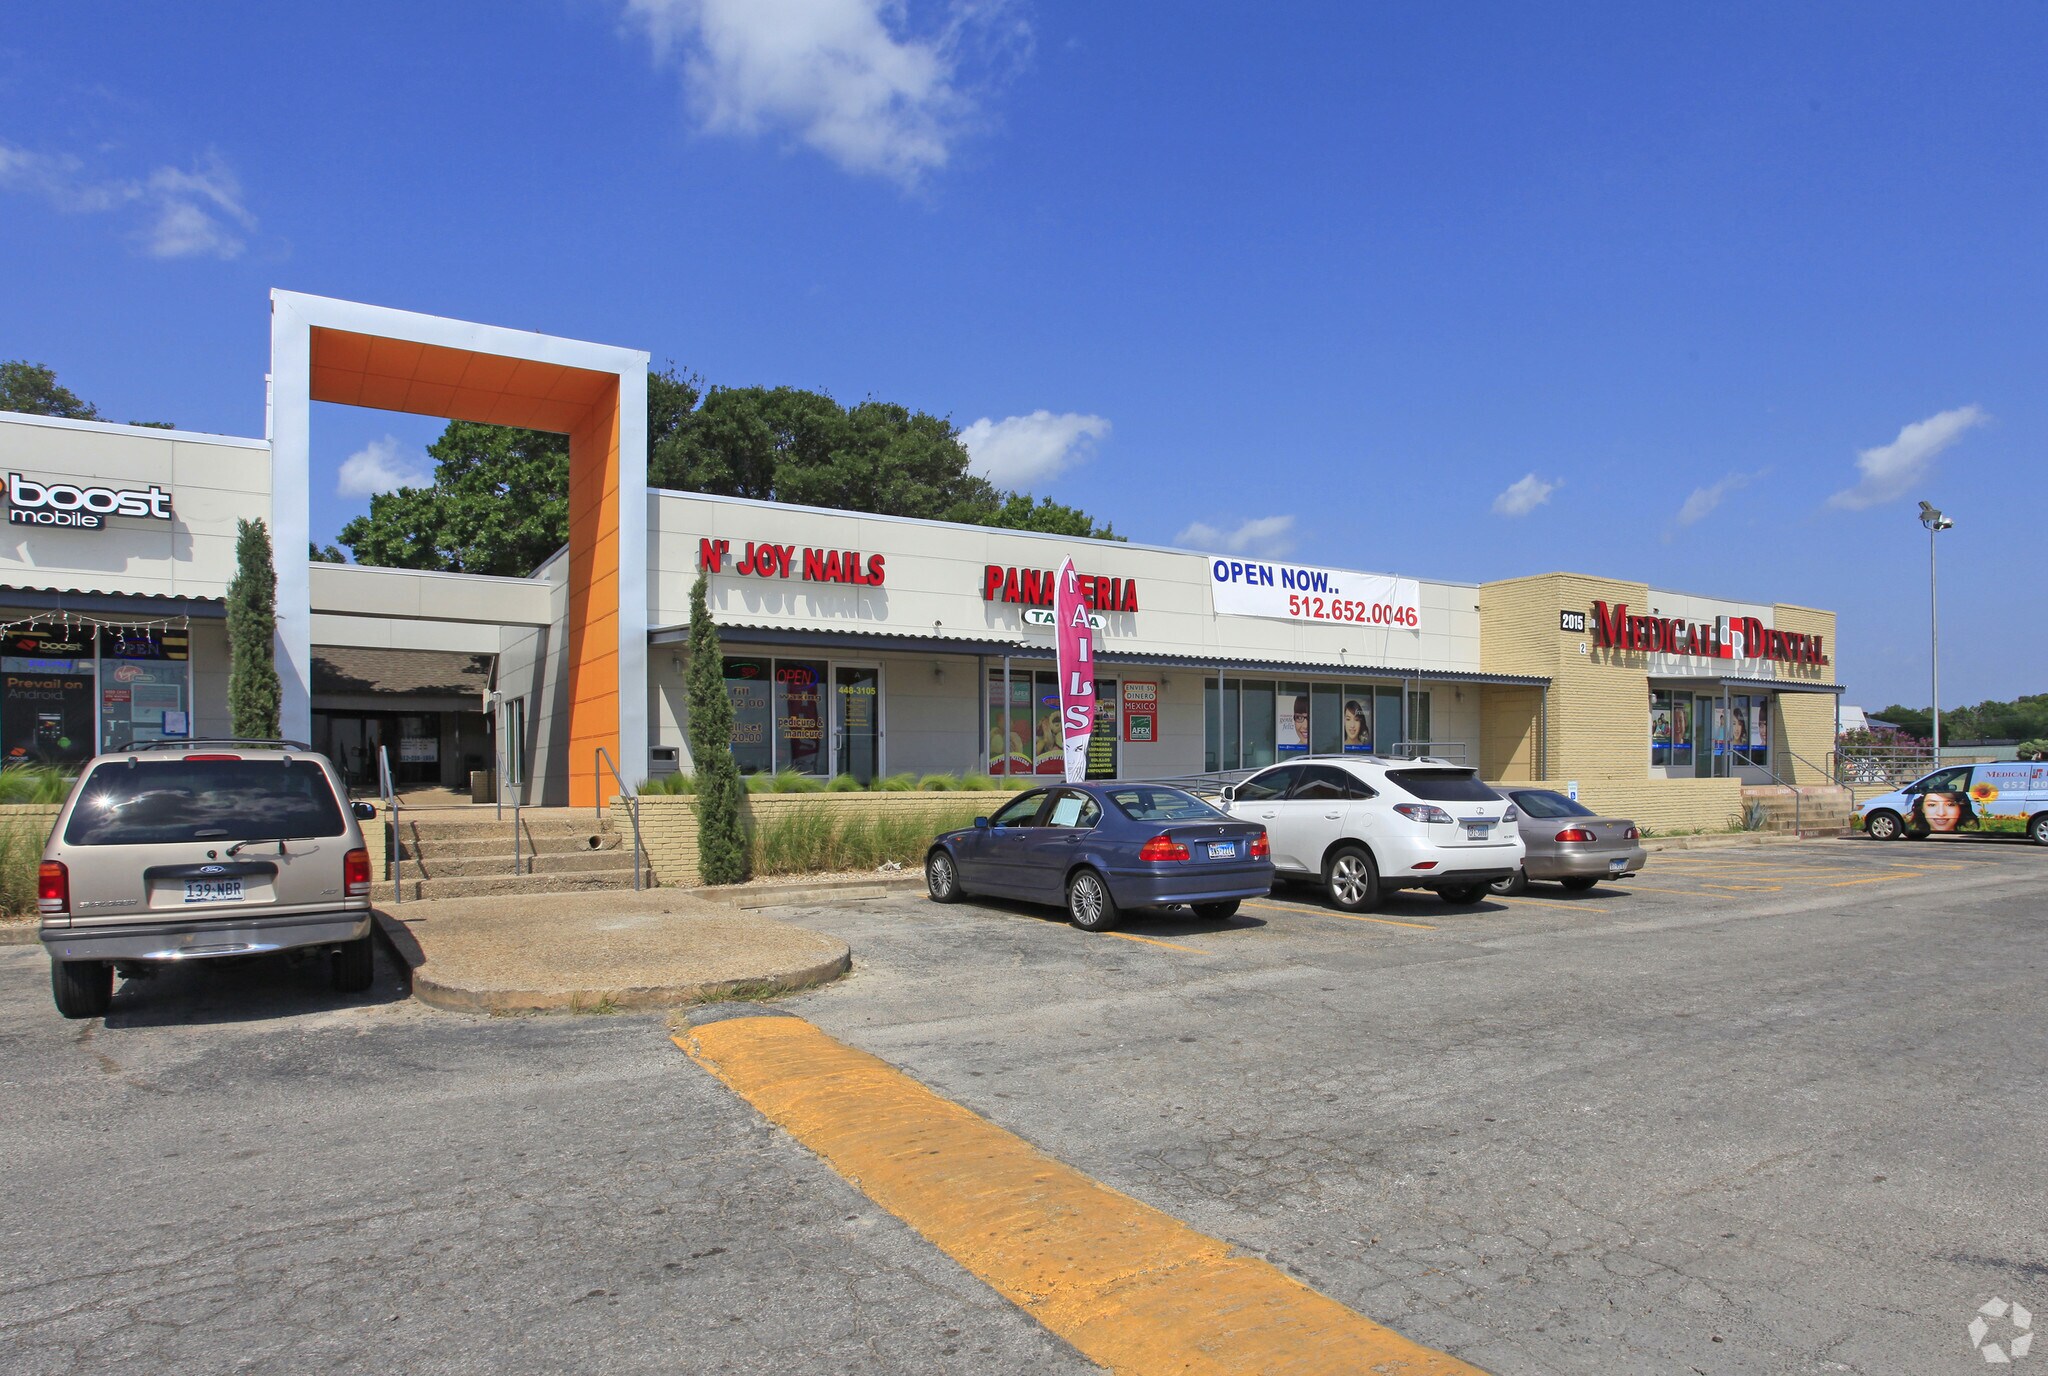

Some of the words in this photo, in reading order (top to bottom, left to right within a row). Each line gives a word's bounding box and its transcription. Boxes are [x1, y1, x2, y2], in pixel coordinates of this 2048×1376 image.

[10, 474, 170, 519] boost
[11, 509, 99, 528] mobile
[699, 538, 730, 573] N'
[736, 541, 796, 579] JOY
[803, 547, 885, 586] NAILS
[1213, 560, 1274, 587] OPEN
[984, 565, 1138, 612] PANAERIA
[1289, 594, 1418, 627] 512.652.0046
[1562, 613, 1584, 631] 2015
[1591, 600, 1719, 658] MEDICAL
[1741, 617, 1829, 666] DENTAL
[39, 640, 83, 652] boost
[1580, 643, 1585, 653] 2
[776, 669, 812, 685] OPEN
[7, 678, 60, 688] Prevail
[64, 681, 83, 689] on
[8, 689, 64, 699] Android
[733, 687, 750, 696] fill
[838, 686, 876, 696] 448-3105
[779, 692, 821, 703] waxing
[1125, 702, 1155, 710] MEXICO
[744, 723, 762, 732] set
[778, 716, 815, 728] pedicure
[817, 717, 824, 727] &
[784, 728, 823, 739] manicure
[187, 884, 211, 898] 139
[217, 882, 241, 896] NBR
